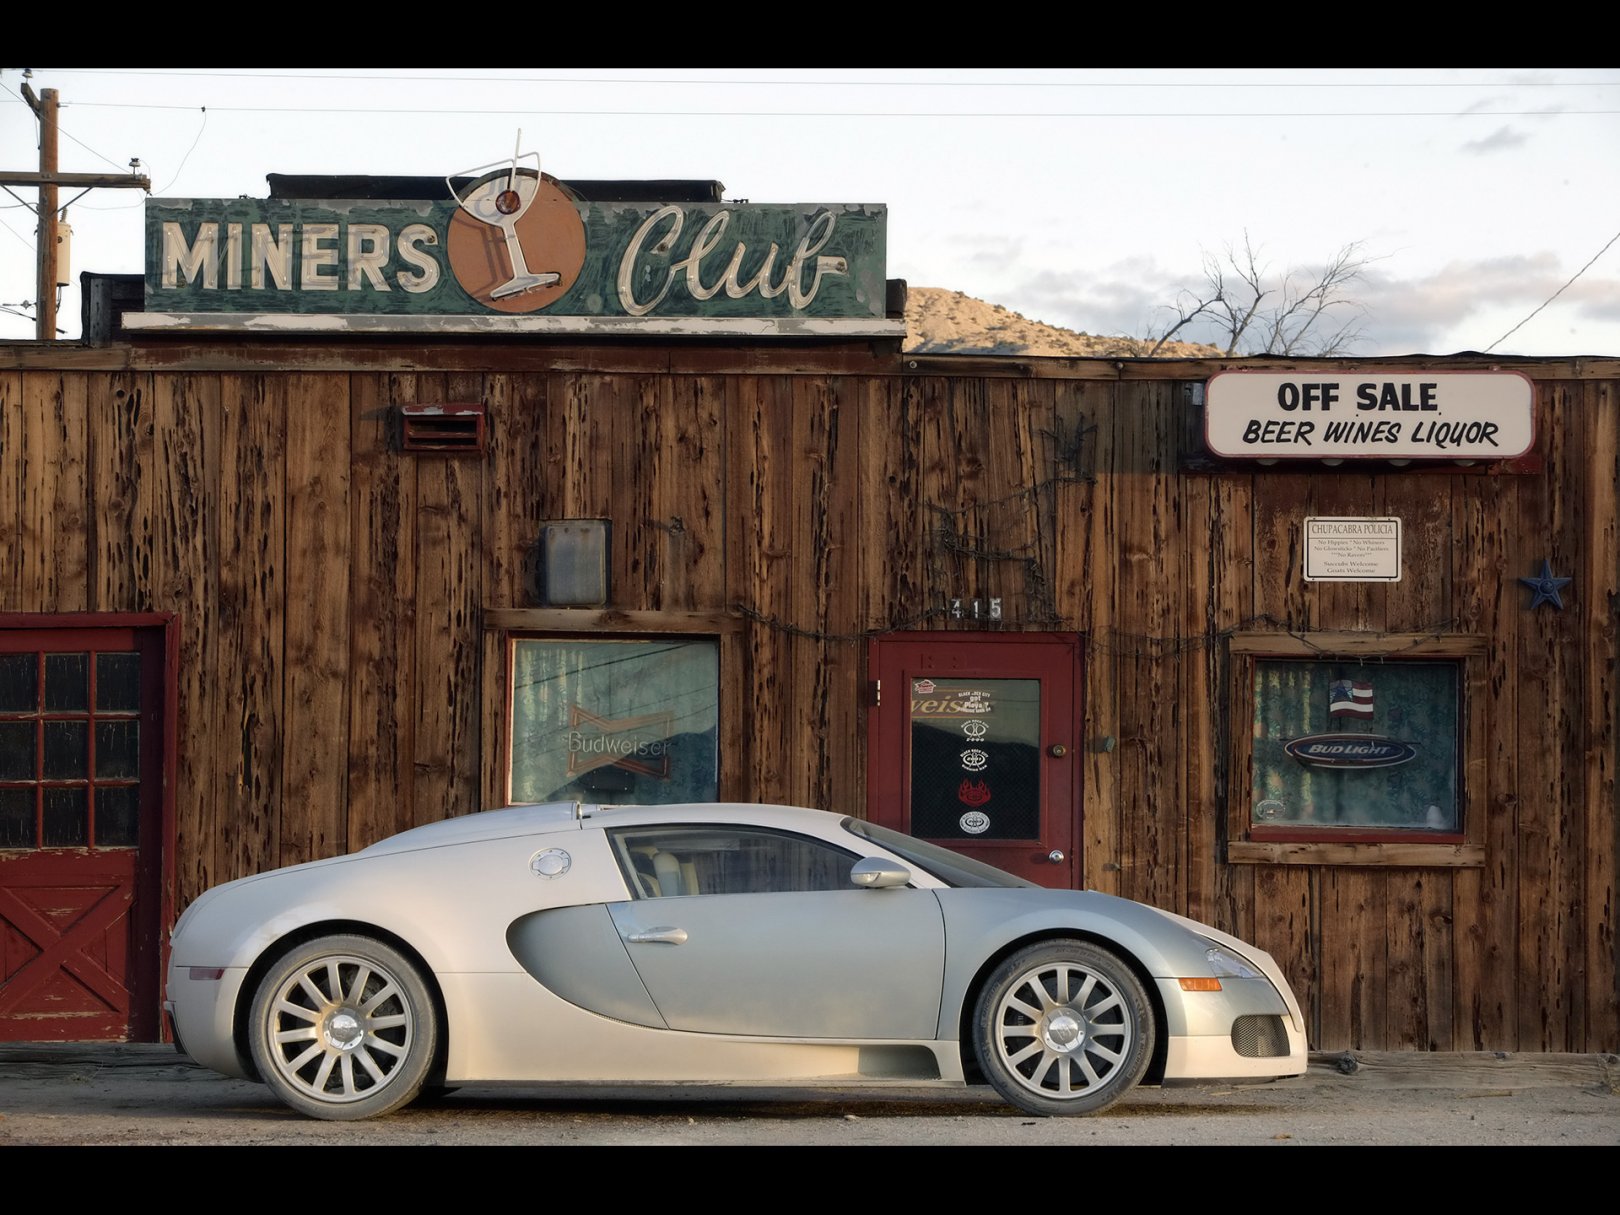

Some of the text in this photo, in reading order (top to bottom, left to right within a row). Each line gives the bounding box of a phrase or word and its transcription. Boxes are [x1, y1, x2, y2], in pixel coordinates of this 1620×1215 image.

[162, 205, 849, 316] MINERS Club
[1277, 382, 1438, 411] OFF SALE
[1243, 420, 1499, 448] BEER WINES LIQUOR
[1311, 524, 1393, 534] CHUPACABRA POLICIA
[951, 599, 1002, 619] 415
[567, 731, 671, 756] Budweiser
[1308, 744, 1391, 754] BUD LIGHT
